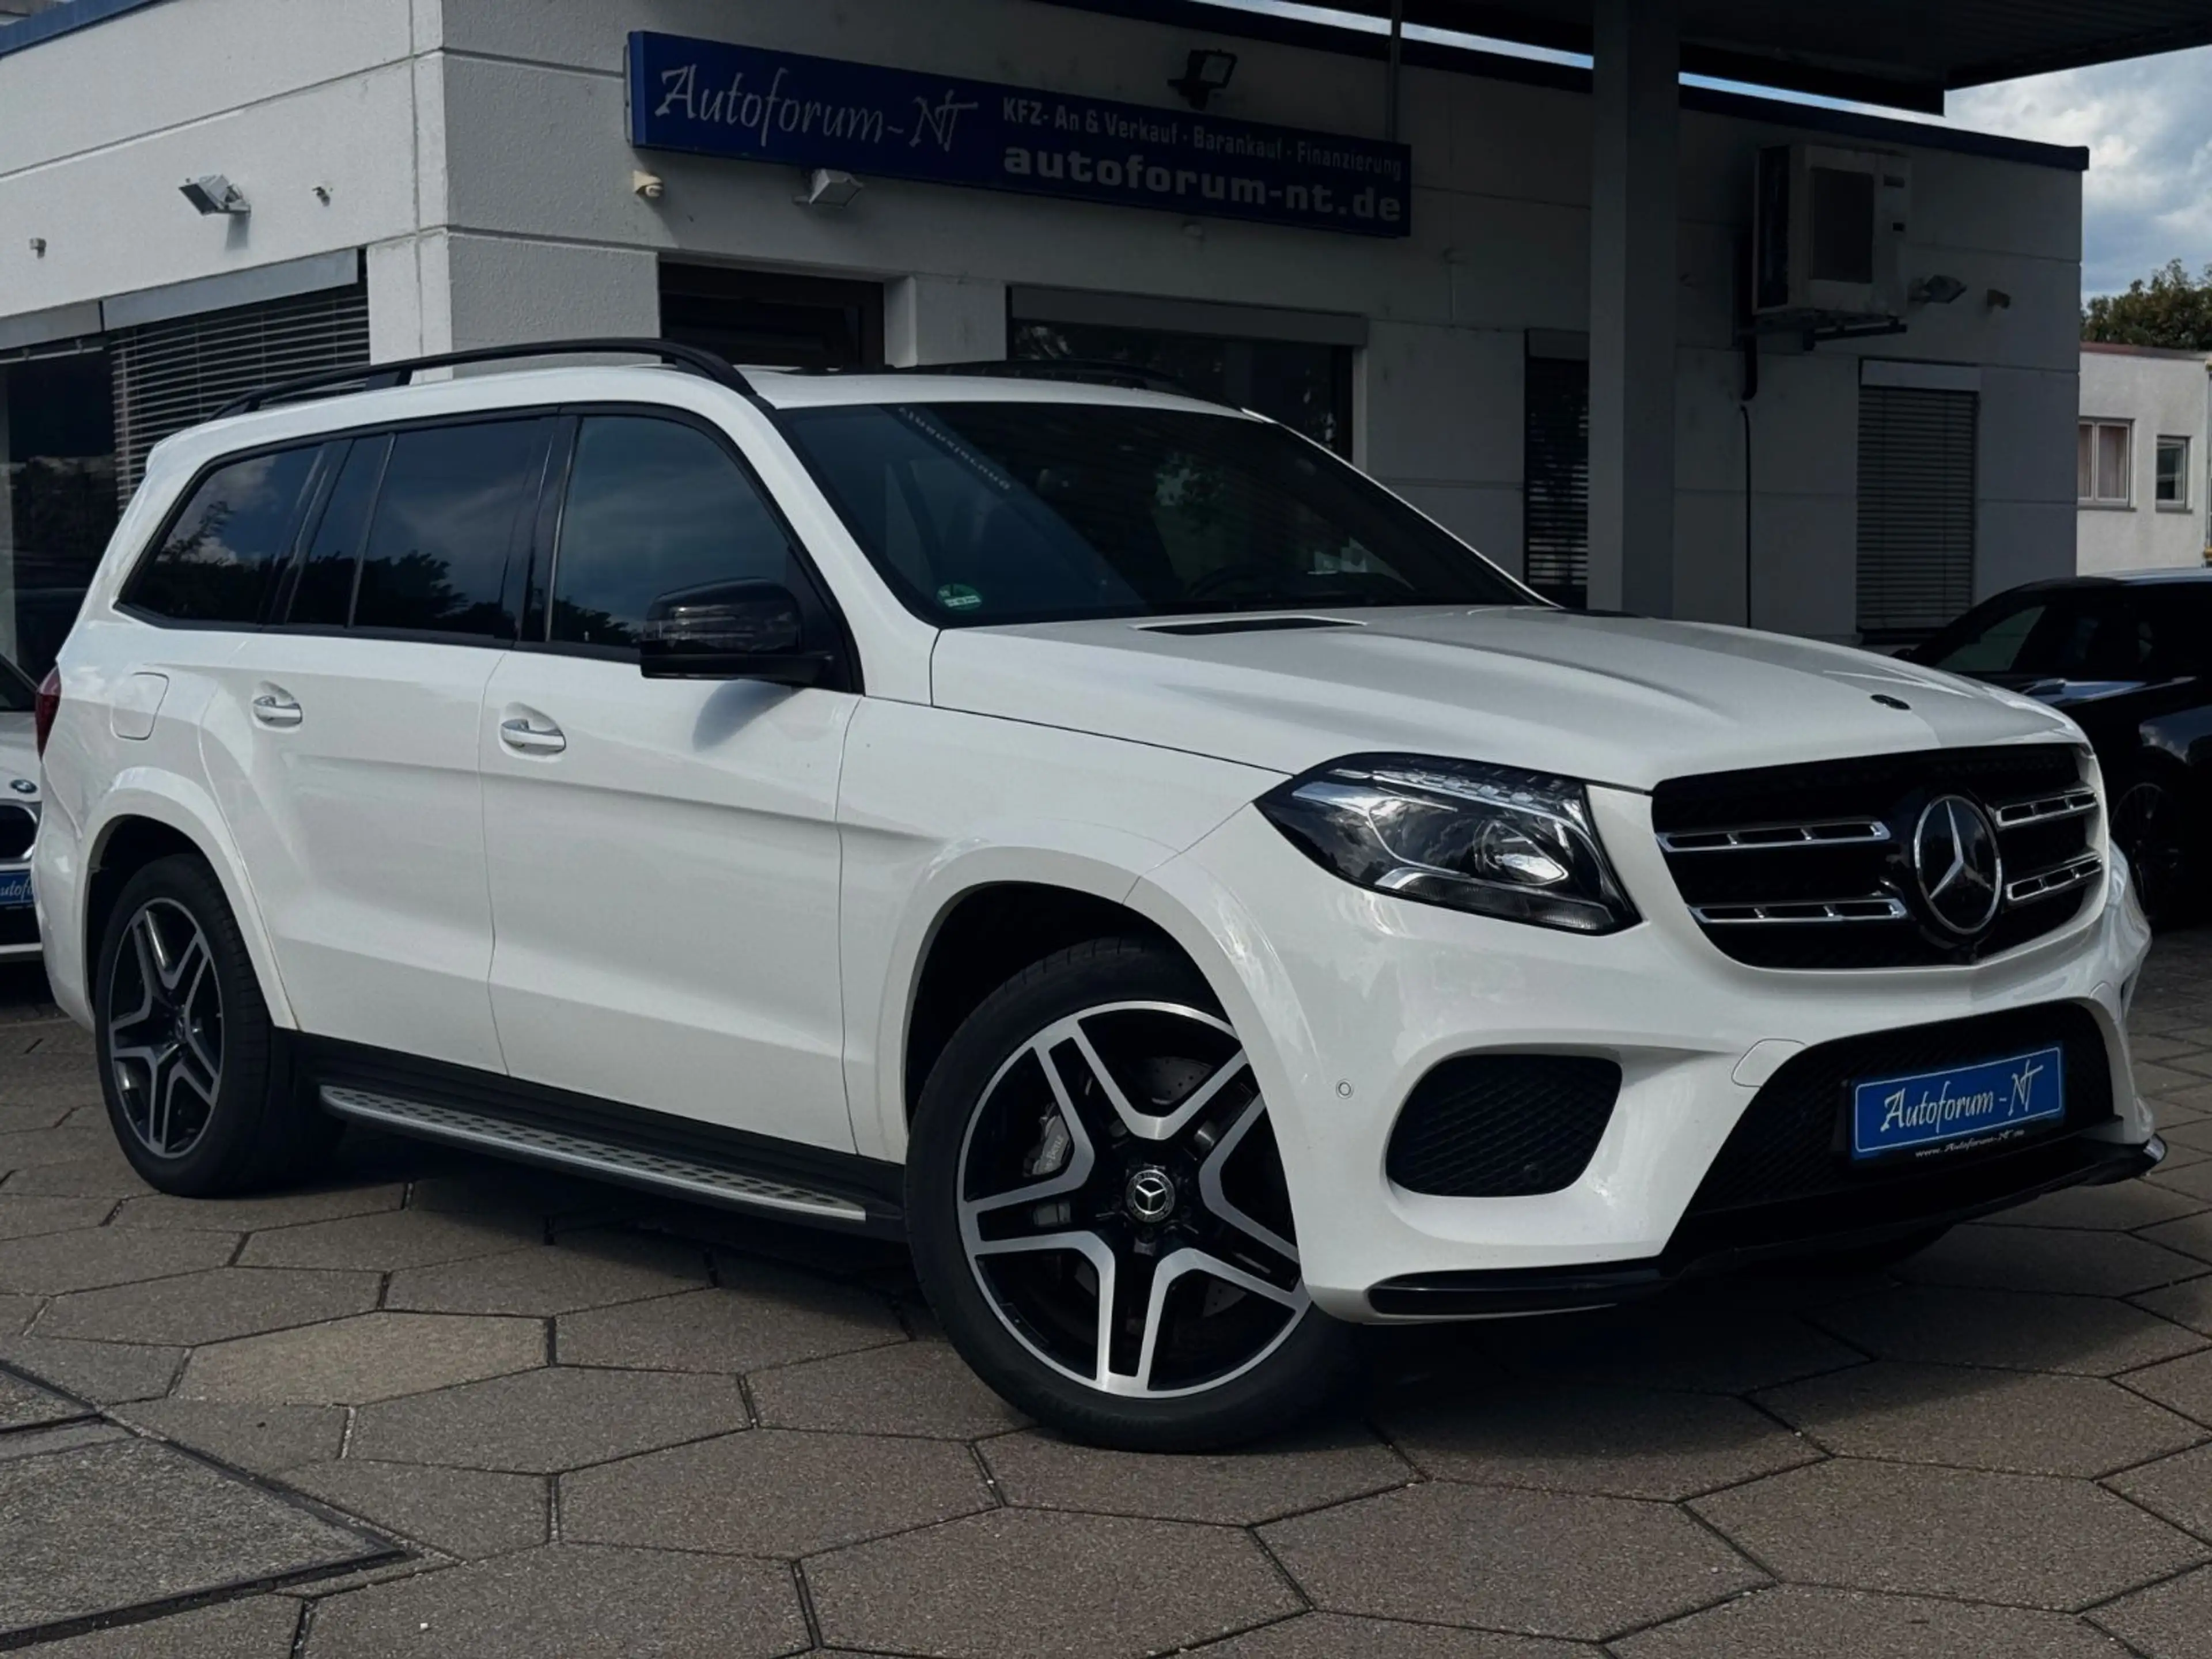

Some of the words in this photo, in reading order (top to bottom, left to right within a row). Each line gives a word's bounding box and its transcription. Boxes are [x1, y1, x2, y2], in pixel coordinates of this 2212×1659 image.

[1003, 96, 1050, 126] KFZ-
[1054, 104, 1080, 132] An
[1084, 108, 1100, 134] &
[1104, 111, 1178, 145] Verkauf
[1193, 124, 1283, 160] Barankauf
[1297, 139, 1402, 182] Finanzierung
[1003, 145, 1401, 222] autoforum-nt.de
